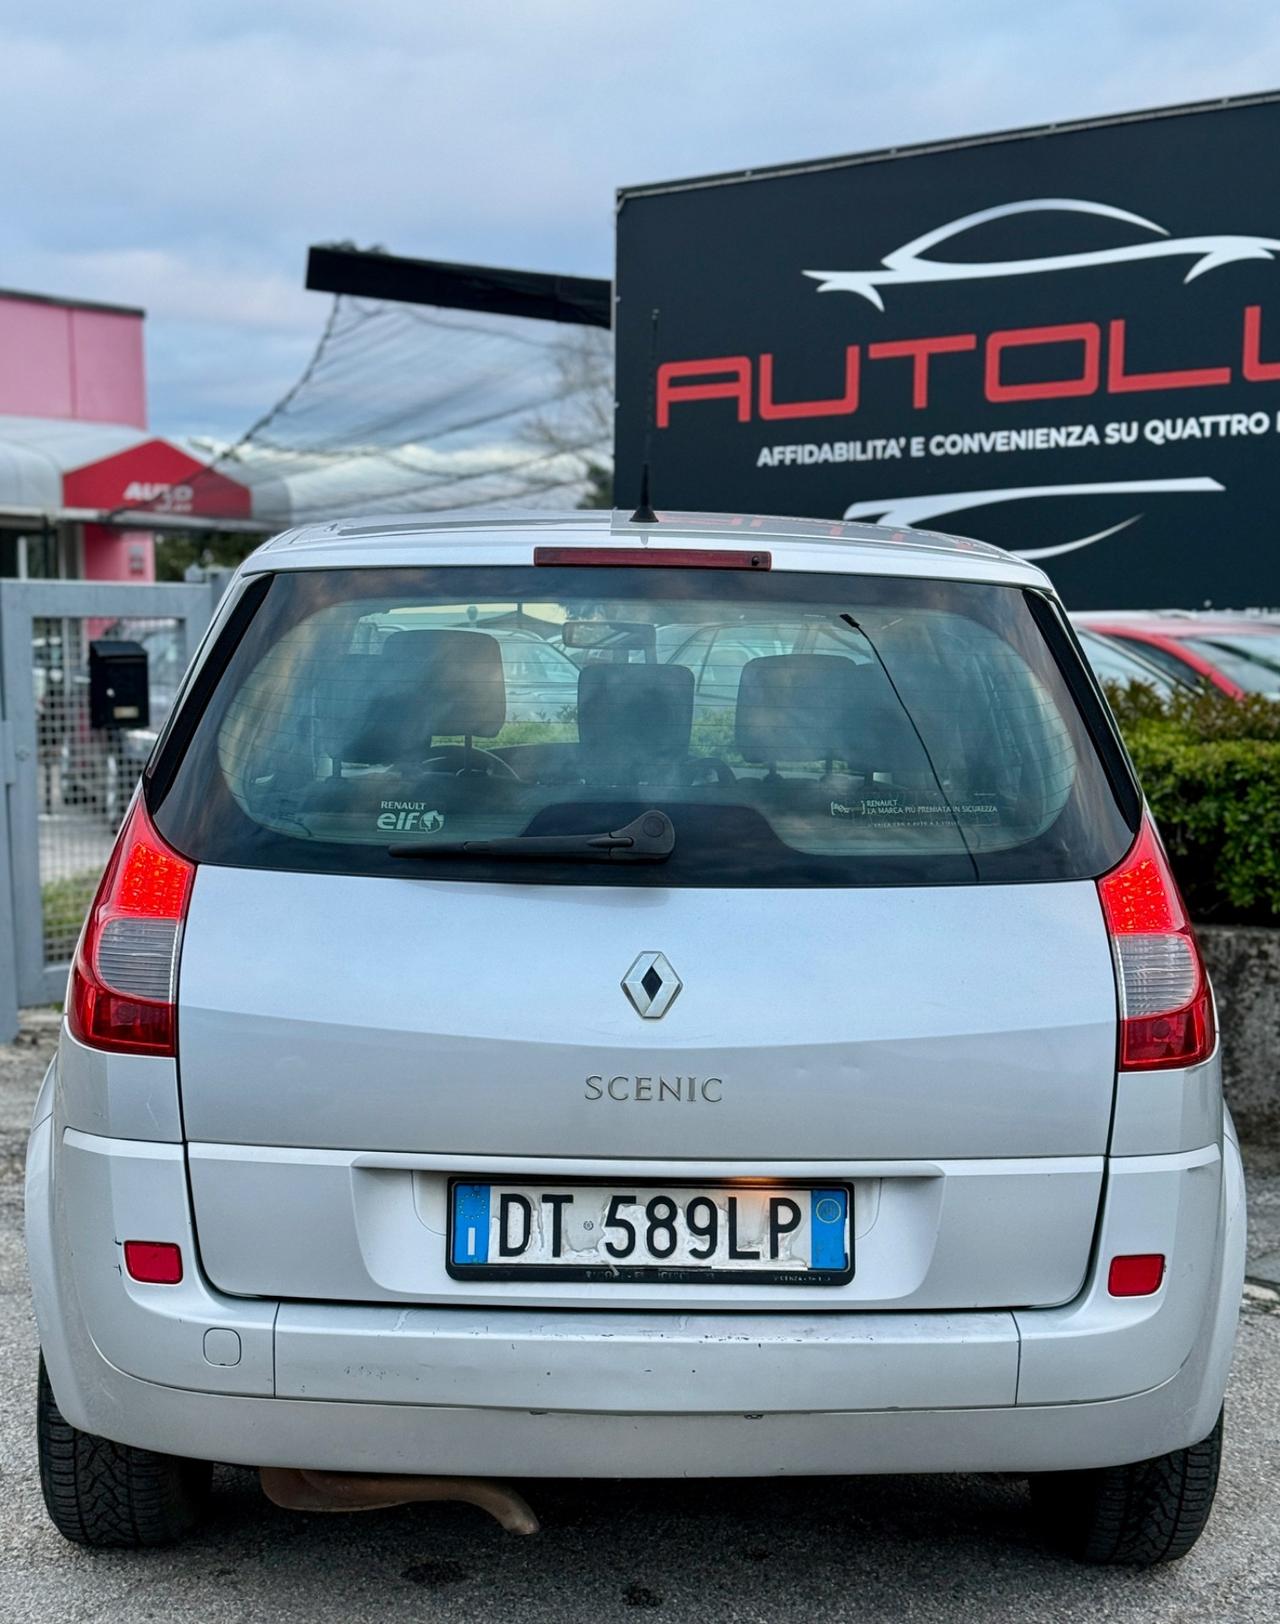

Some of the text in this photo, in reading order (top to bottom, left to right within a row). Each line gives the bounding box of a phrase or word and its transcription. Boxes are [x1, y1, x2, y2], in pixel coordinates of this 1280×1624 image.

[757, 437, 906, 467] AFFIDABILITA'
[910, 436, 926, 457] E
[929, 424, 1100, 456] CONVENIENZA
[1104, 421, 1139, 445] SU
[1144, 411, 1270, 445] QUATTRO
[380, 800, 427, 810] RENAULT
[866, 799, 898, 807] RENAULT
[878, 806, 904, 814] MARCA
[917, 805, 951, 813] PREMIATA
[961, 805, 998, 813] SICUREZZA
[376, 811, 421, 830] elf
[584, 1074, 724, 1103] SCENIC
[499, 1193, 574, 1258] DT
[603, 1194, 802, 1260] 589LP
